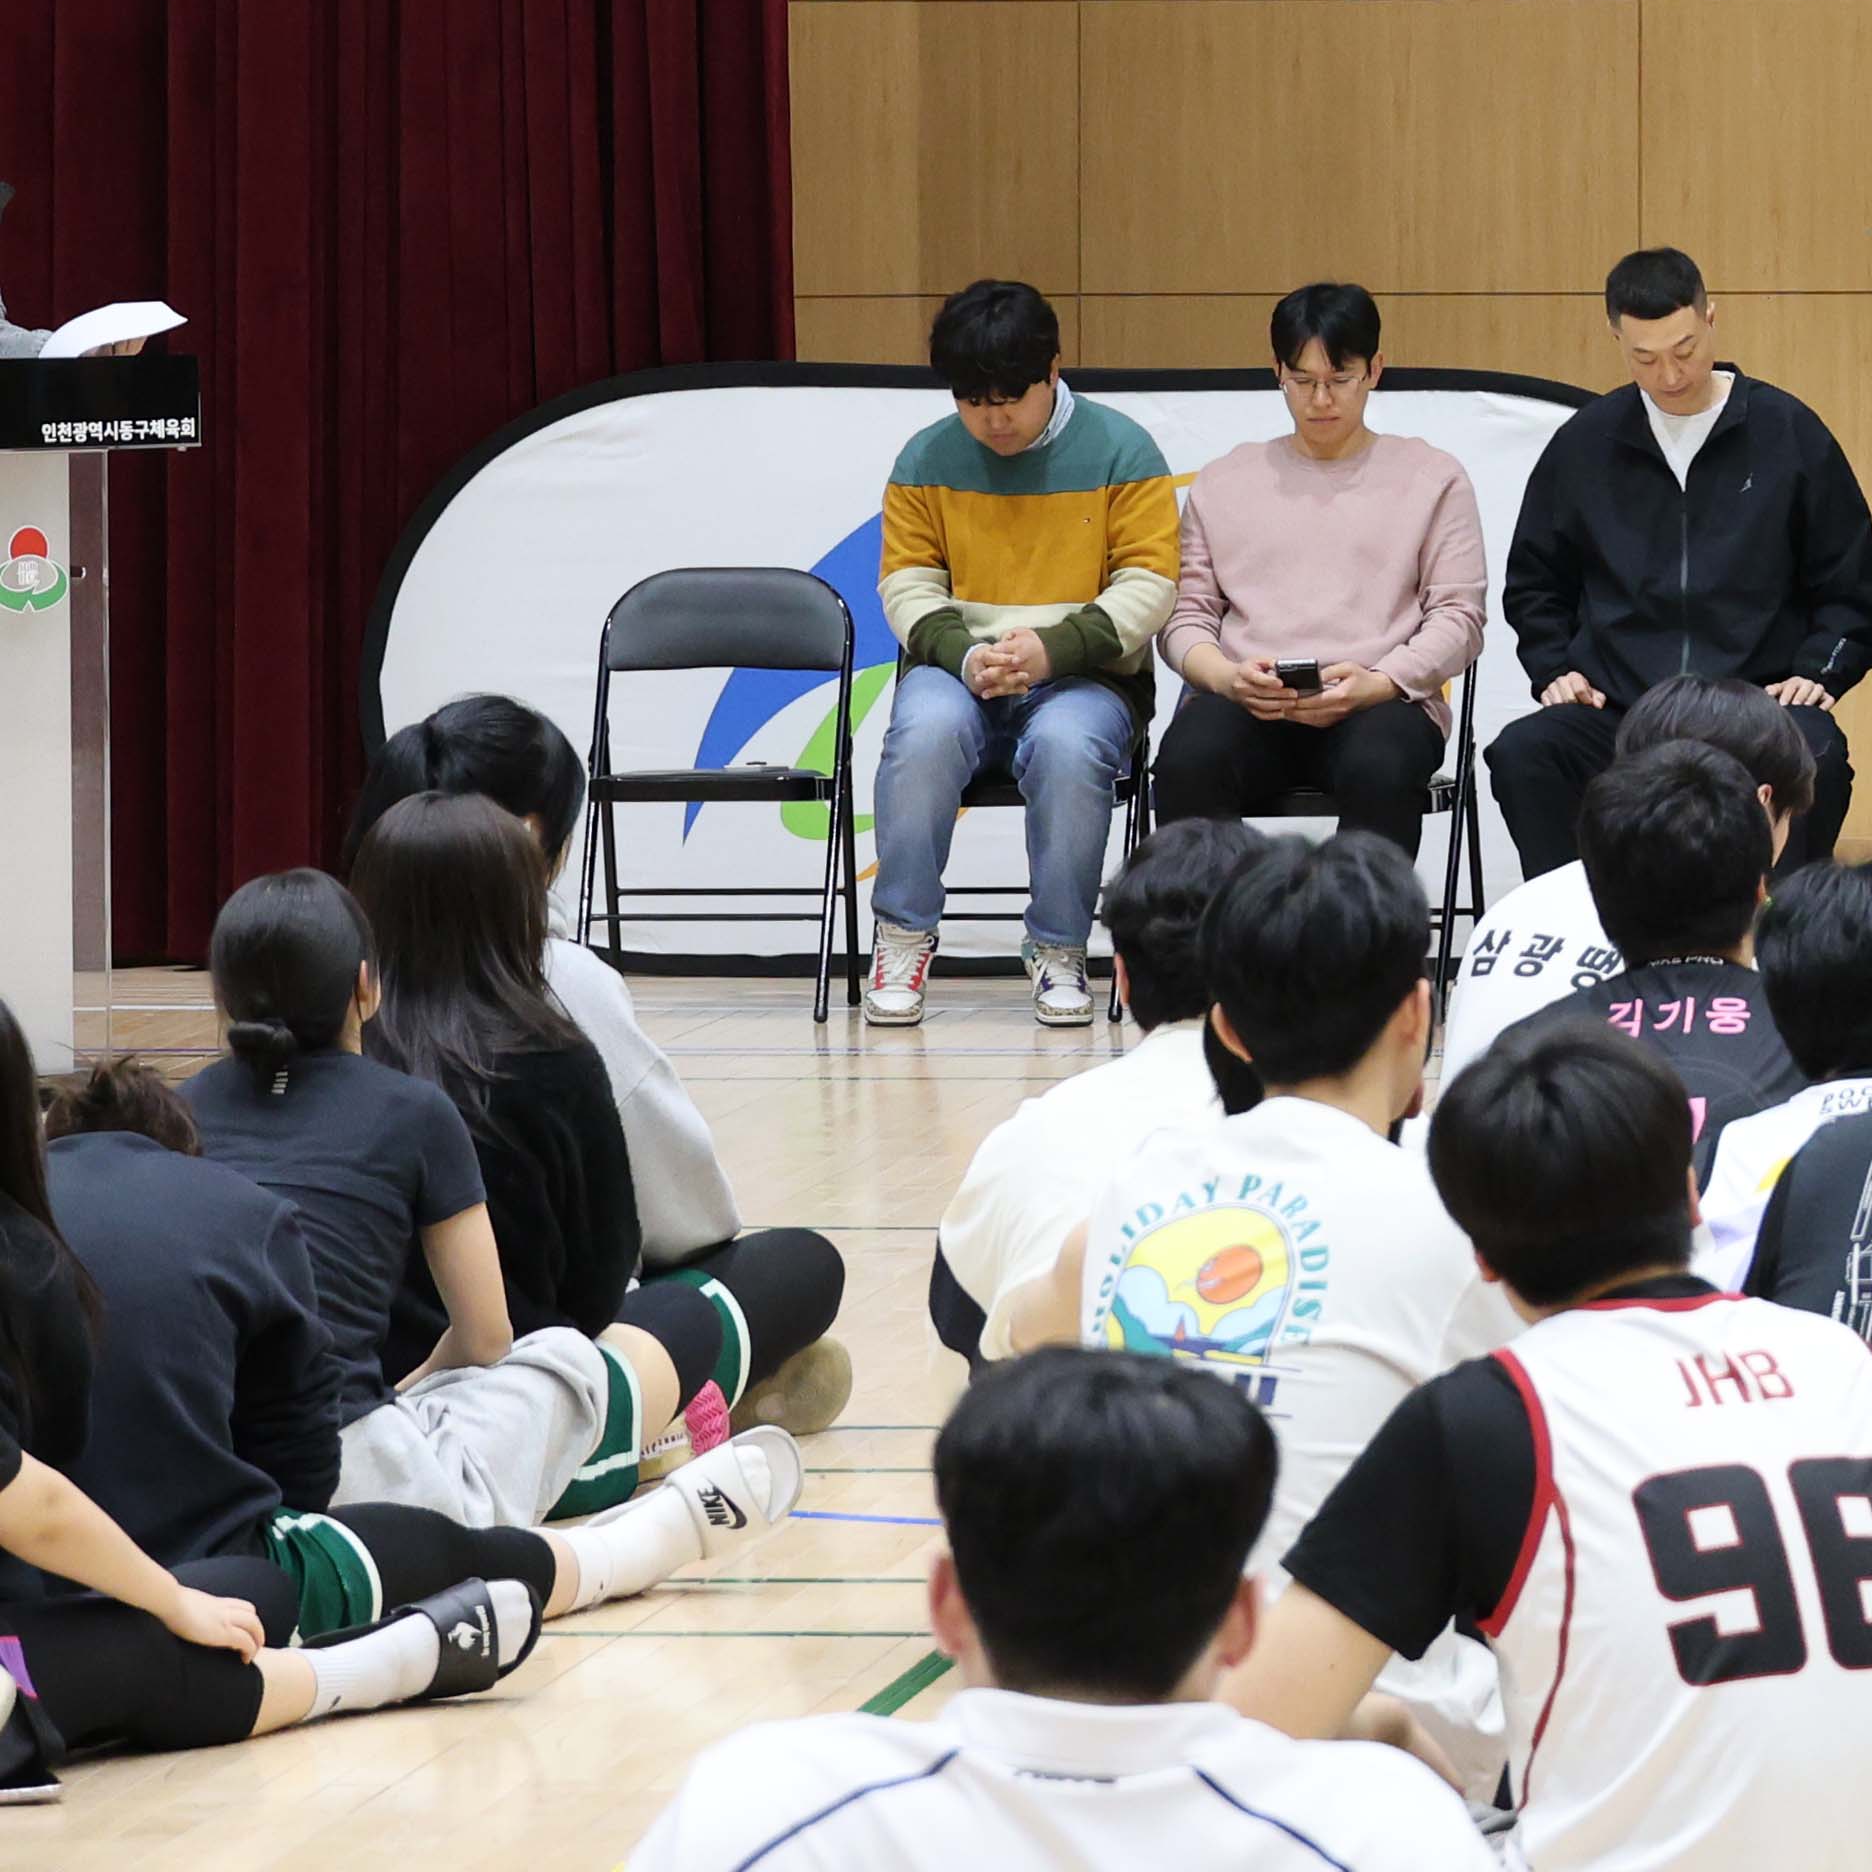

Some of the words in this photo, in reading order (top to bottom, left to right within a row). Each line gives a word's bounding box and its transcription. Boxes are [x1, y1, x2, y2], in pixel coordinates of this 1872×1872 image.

[41, 417, 196, 443] 인천광역시동구체육회
[1237, 1172, 1332, 1346] PARADISE
[1673, 1349, 1797, 1408] JHB
[696, 1485, 731, 1527] NIKE
